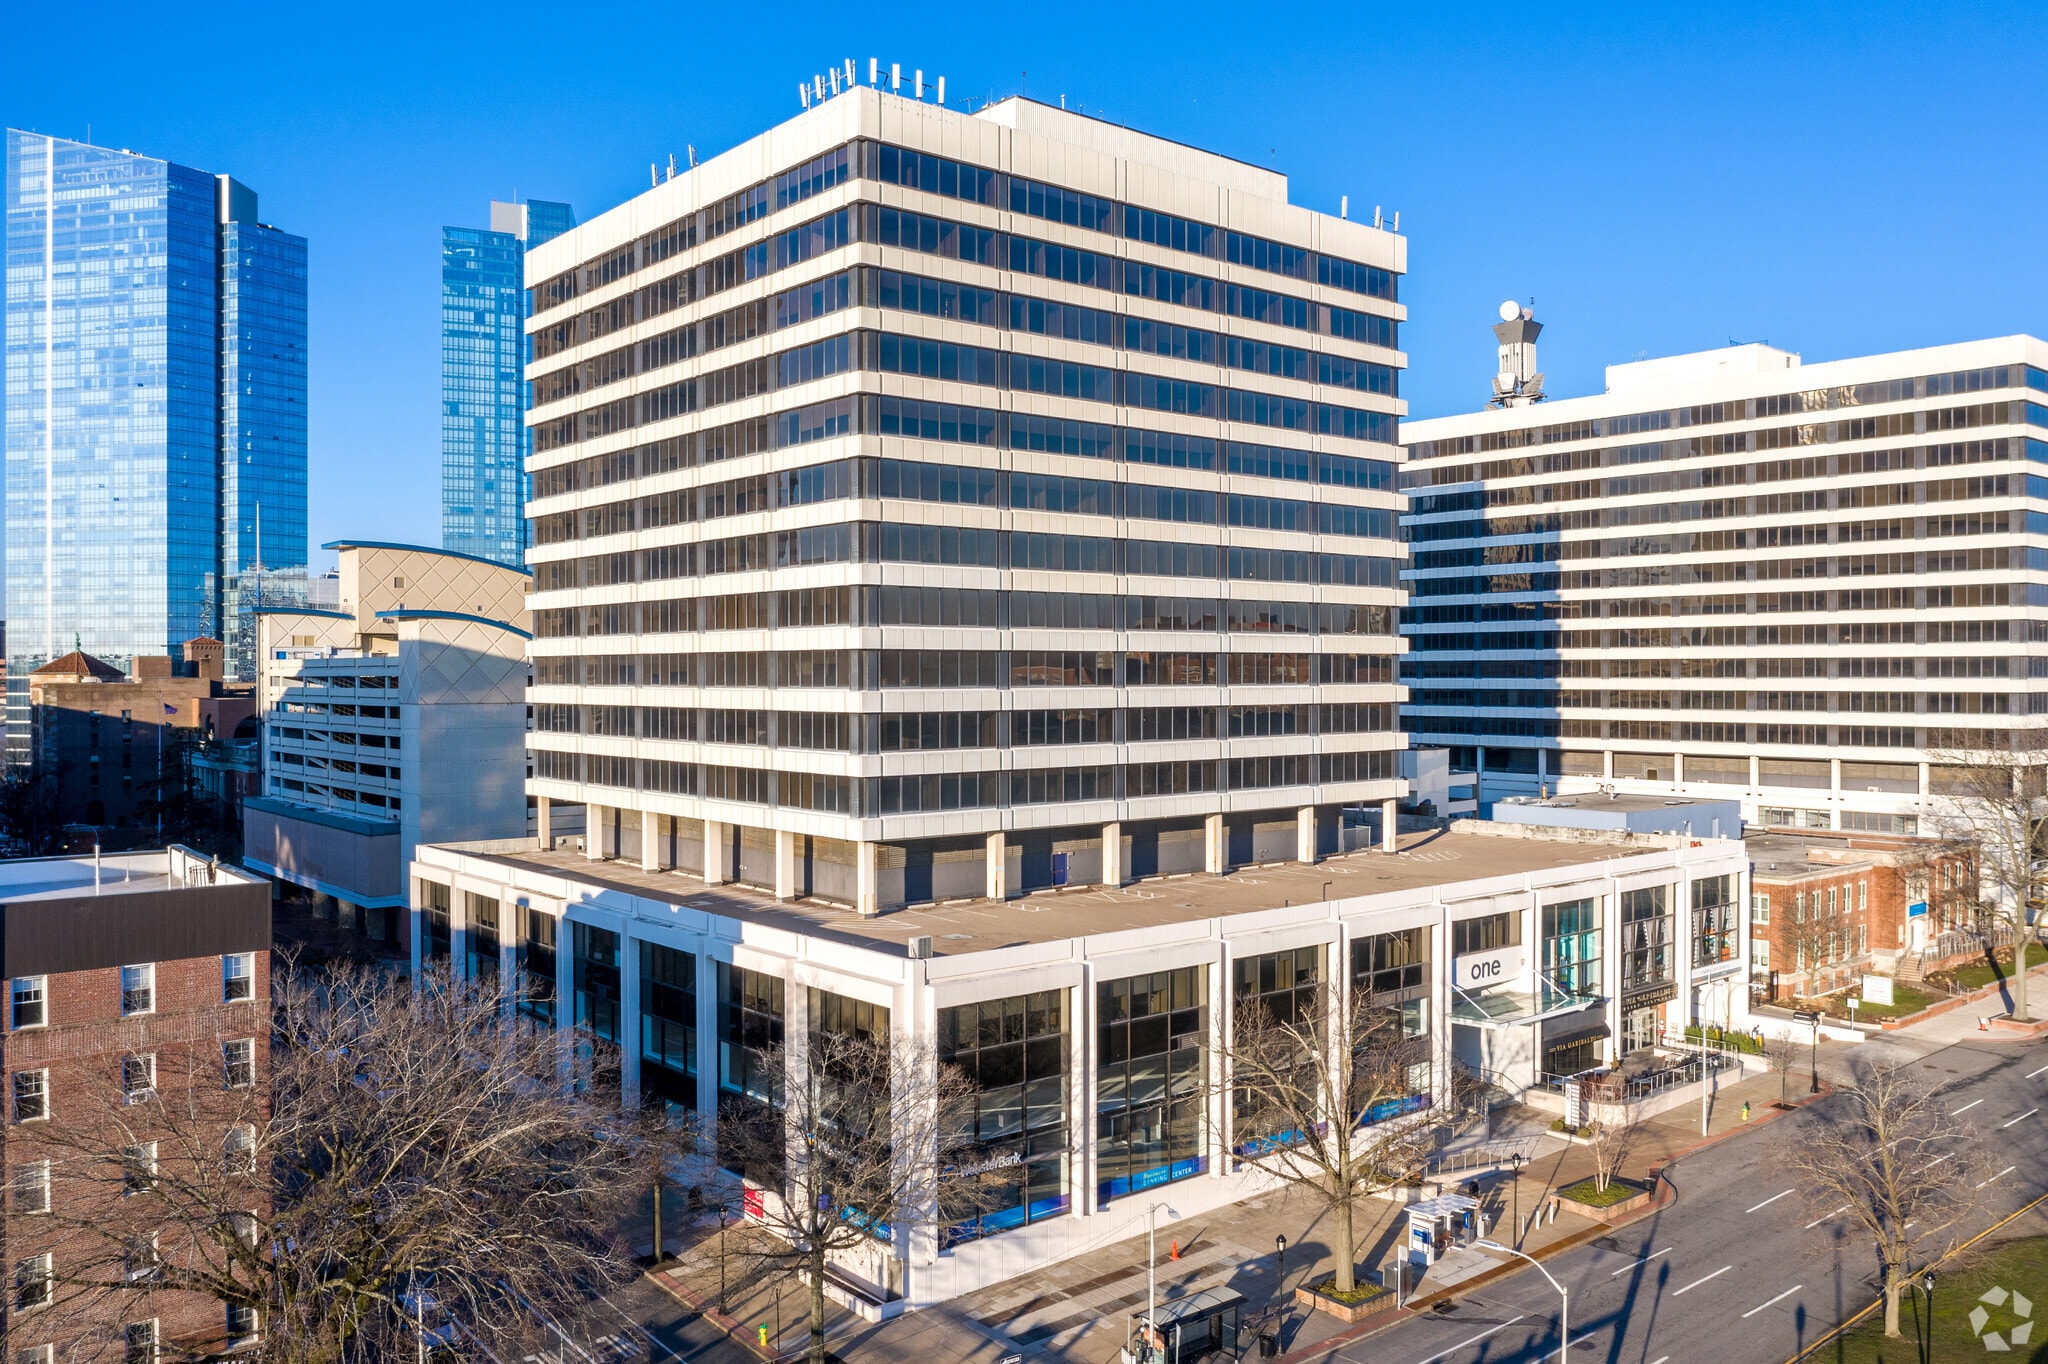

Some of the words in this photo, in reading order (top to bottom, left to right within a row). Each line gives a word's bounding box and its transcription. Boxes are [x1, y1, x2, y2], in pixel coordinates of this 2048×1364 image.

[1471, 960, 1501, 980] one
[1556, 1044, 1566, 1052] VIA
[1567, 1035, 1597, 1049] GARIBALDI
[1172, 1166, 1192, 1178] CENTER
